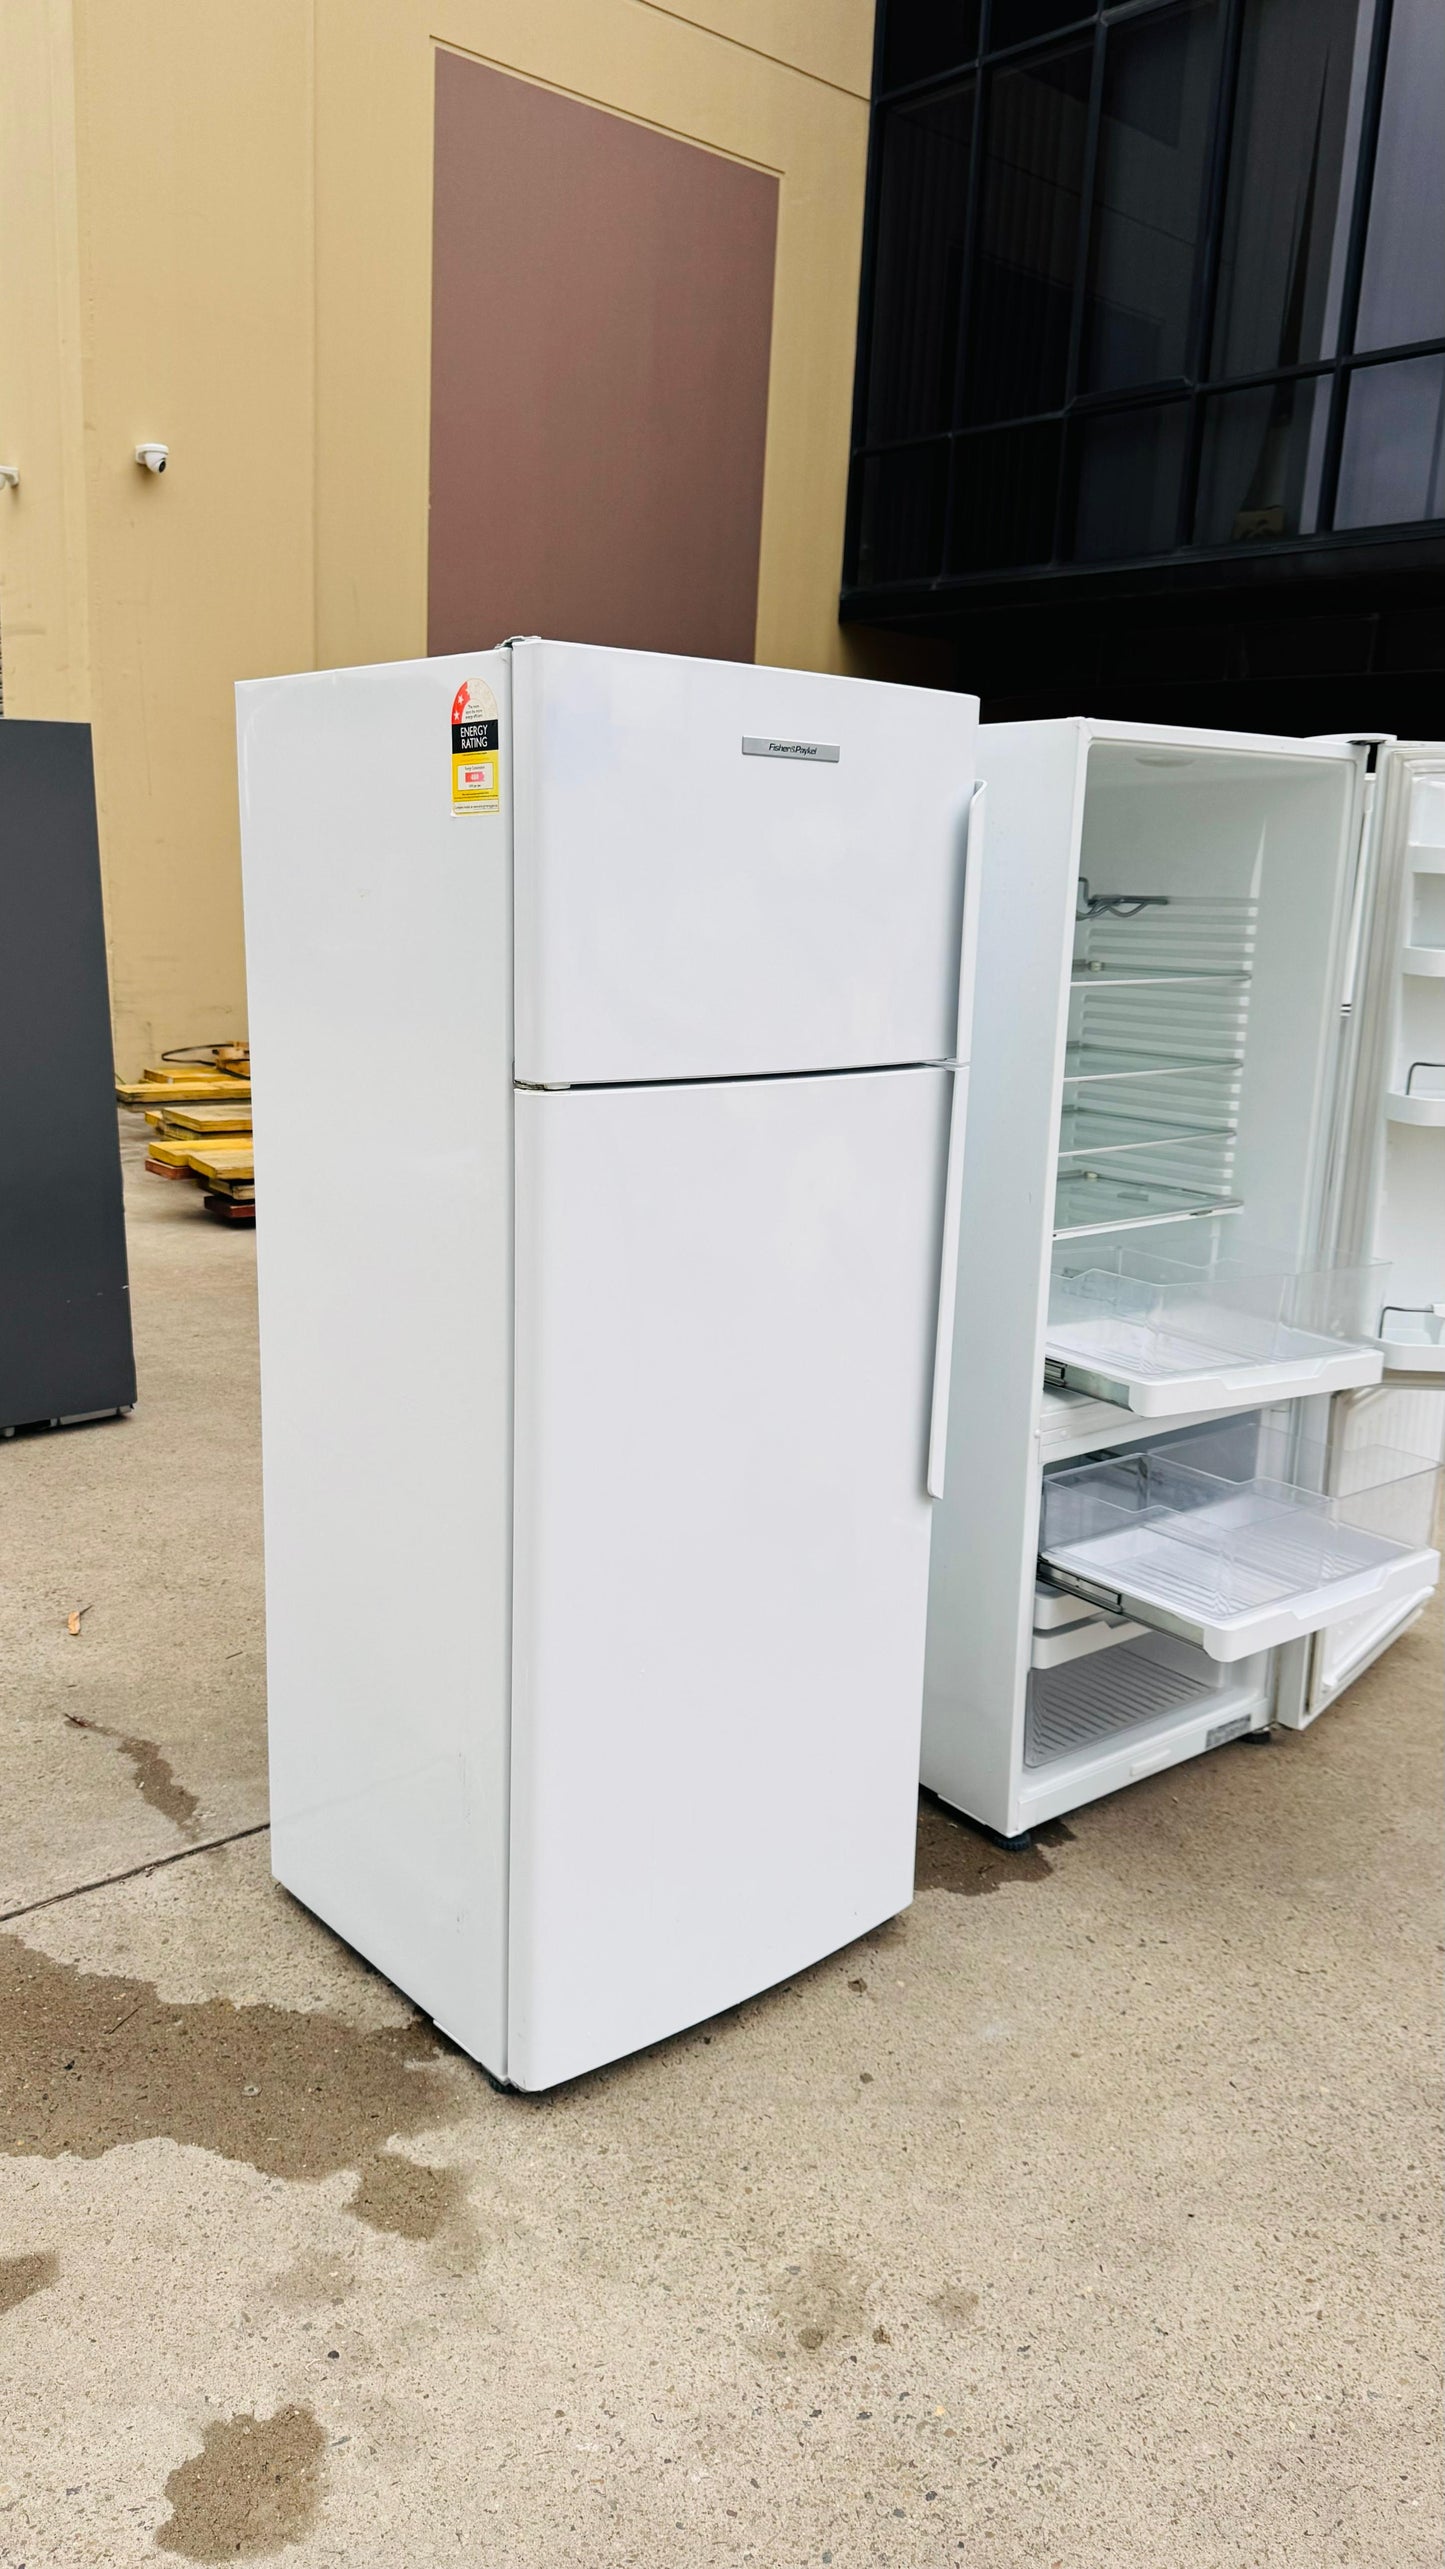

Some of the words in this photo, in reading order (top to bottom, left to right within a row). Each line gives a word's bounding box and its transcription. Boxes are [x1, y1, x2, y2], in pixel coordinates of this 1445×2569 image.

[460, 724, 488, 737] ENERGY
[461, 736, 488, 749] RATING
[768, 743, 818, 756] Fisher&Paykel
